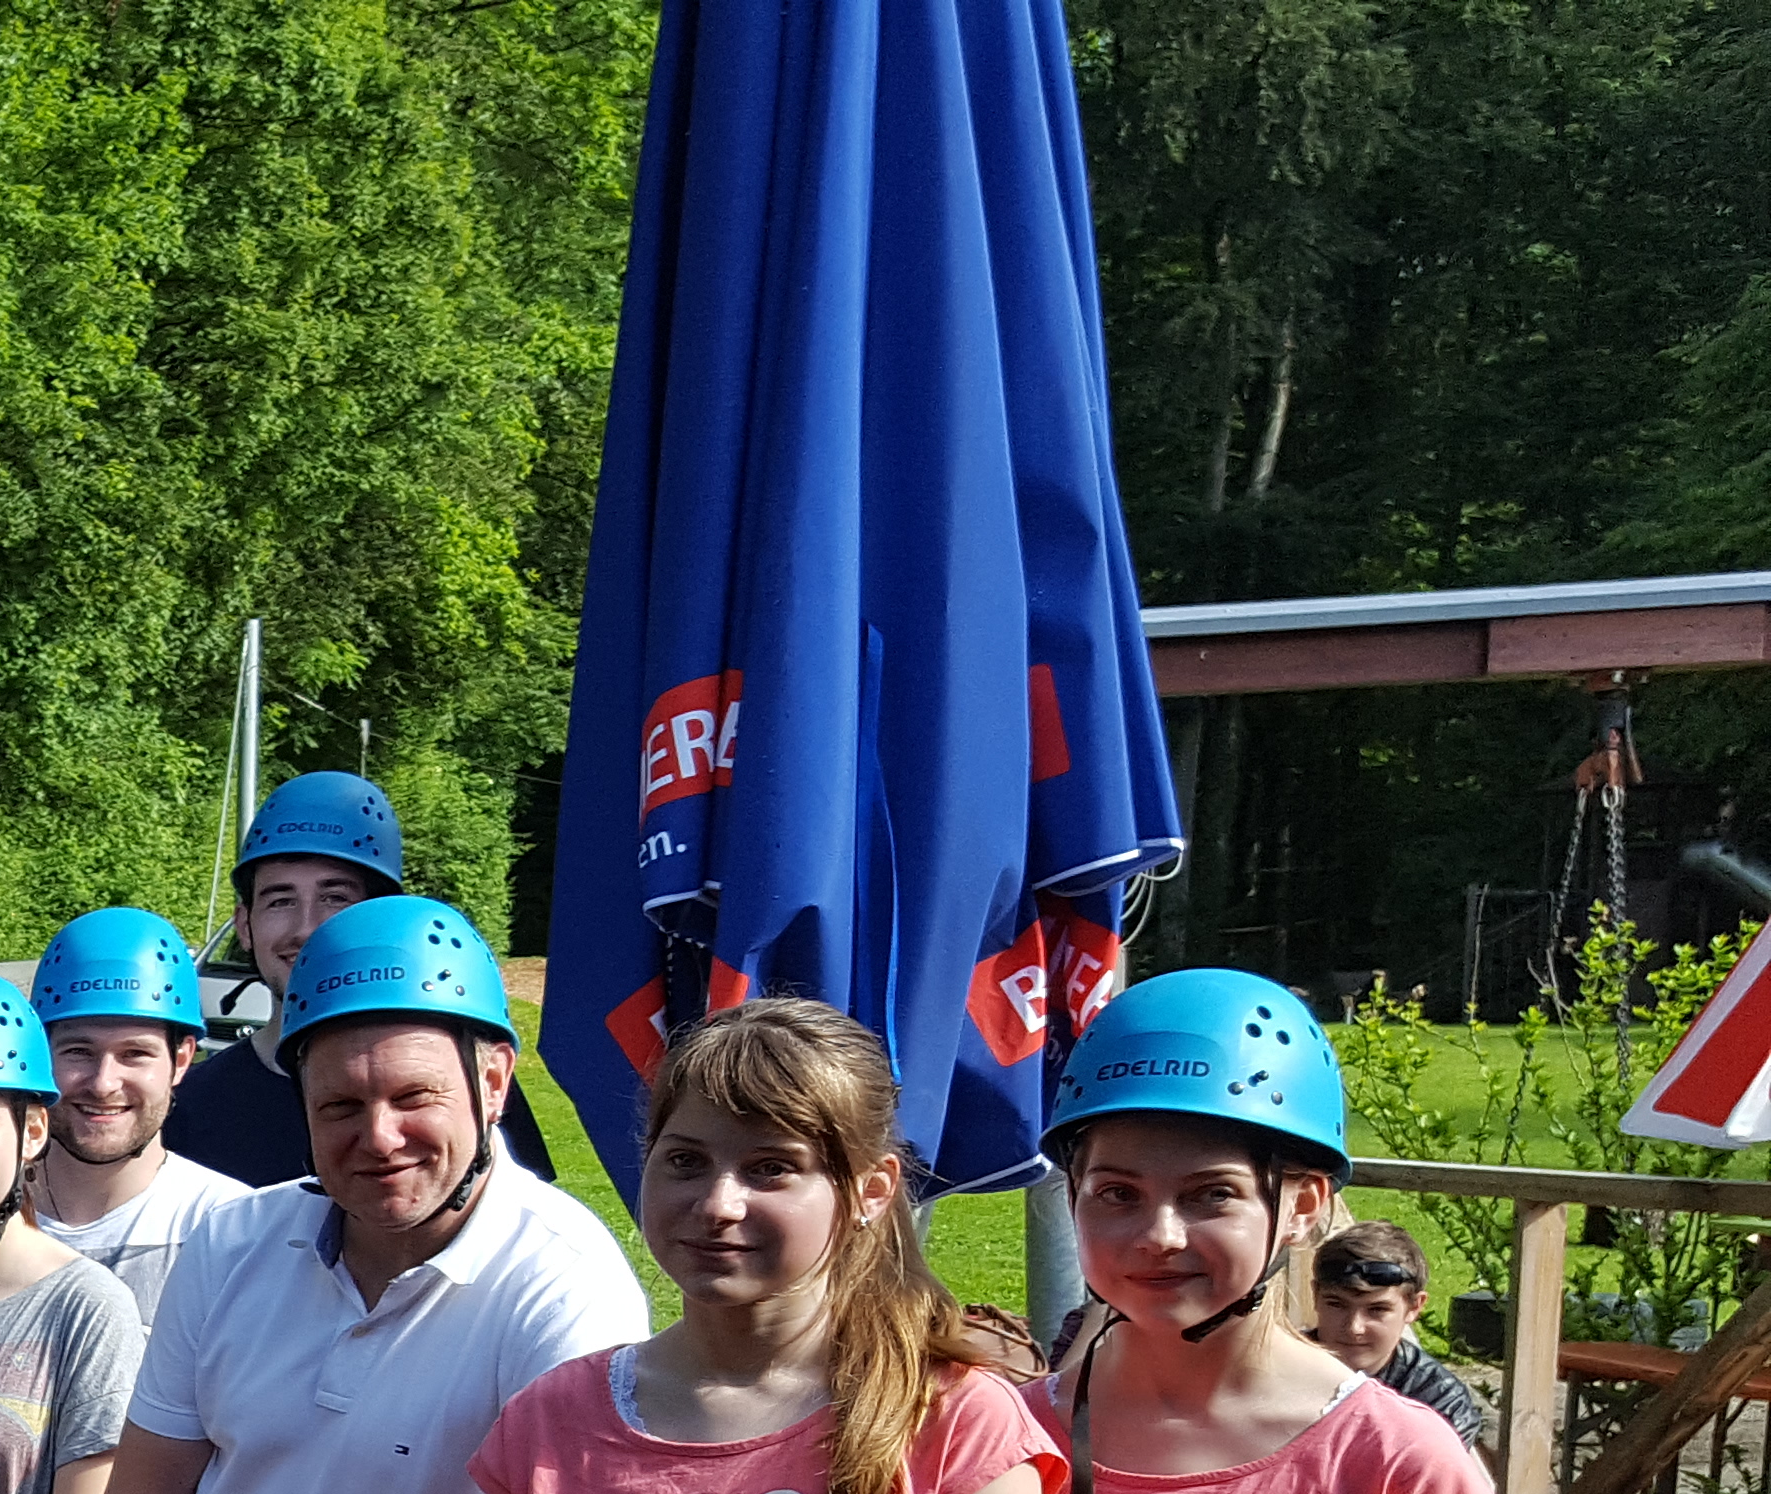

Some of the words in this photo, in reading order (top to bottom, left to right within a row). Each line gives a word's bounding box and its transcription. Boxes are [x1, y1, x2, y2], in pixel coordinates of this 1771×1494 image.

[277, 822, 343, 835] EDELRID
[70, 979, 140, 993] EDELRID
[316, 967, 405, 993] EDELRID
[1097, 1060, 1210, 1081] EDELRID
